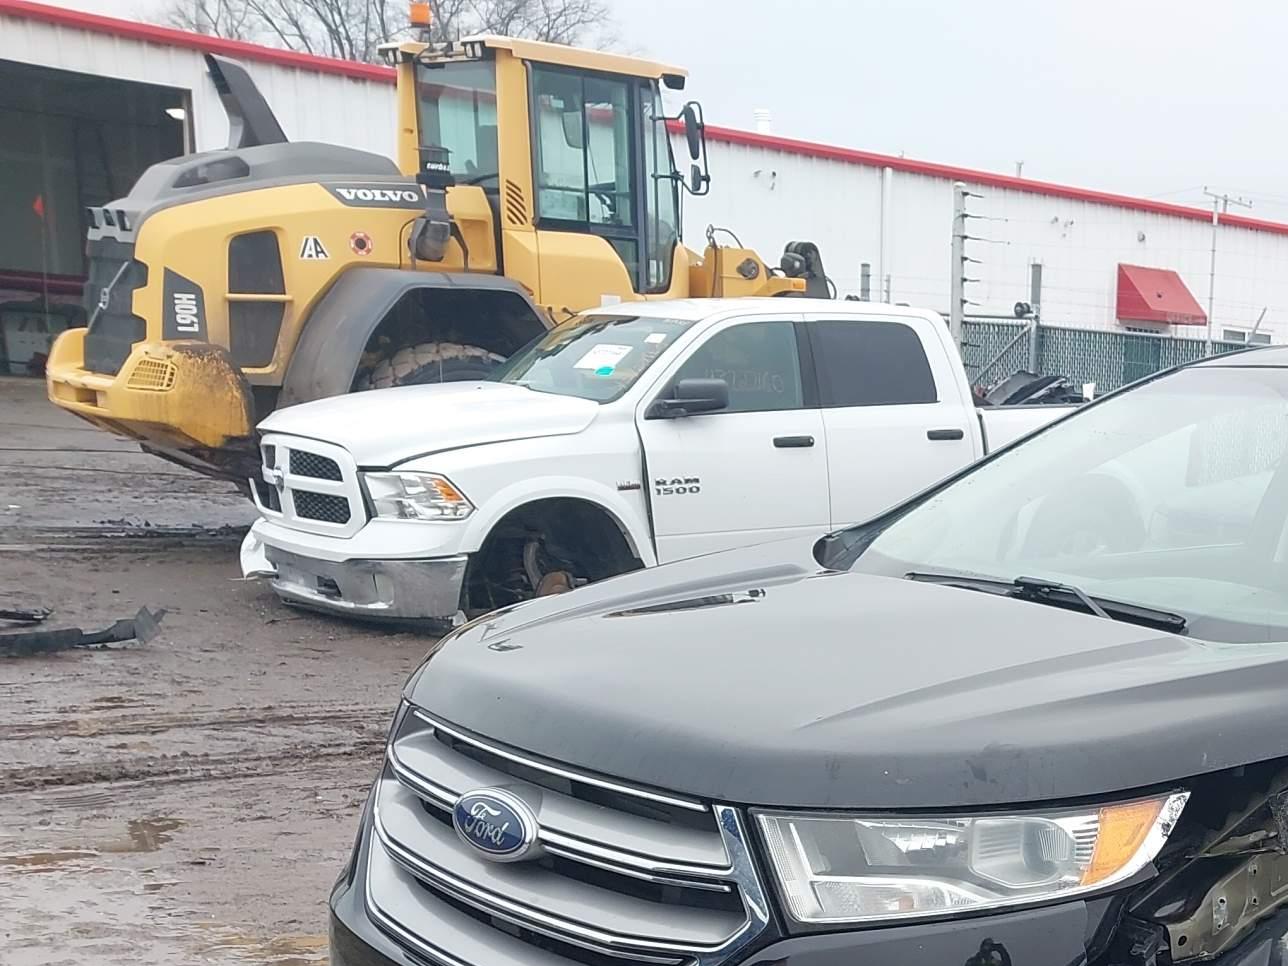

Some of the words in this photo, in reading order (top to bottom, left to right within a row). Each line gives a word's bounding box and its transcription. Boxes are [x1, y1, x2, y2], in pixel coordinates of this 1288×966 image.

[336, 188, 419, 202] VOLVO
[173, 293, 199, 332] L90H
[655, 478, 700, 486] RAM
[655, 486, 701, 495] 1500
[464, 801, 510, 845] Ford
